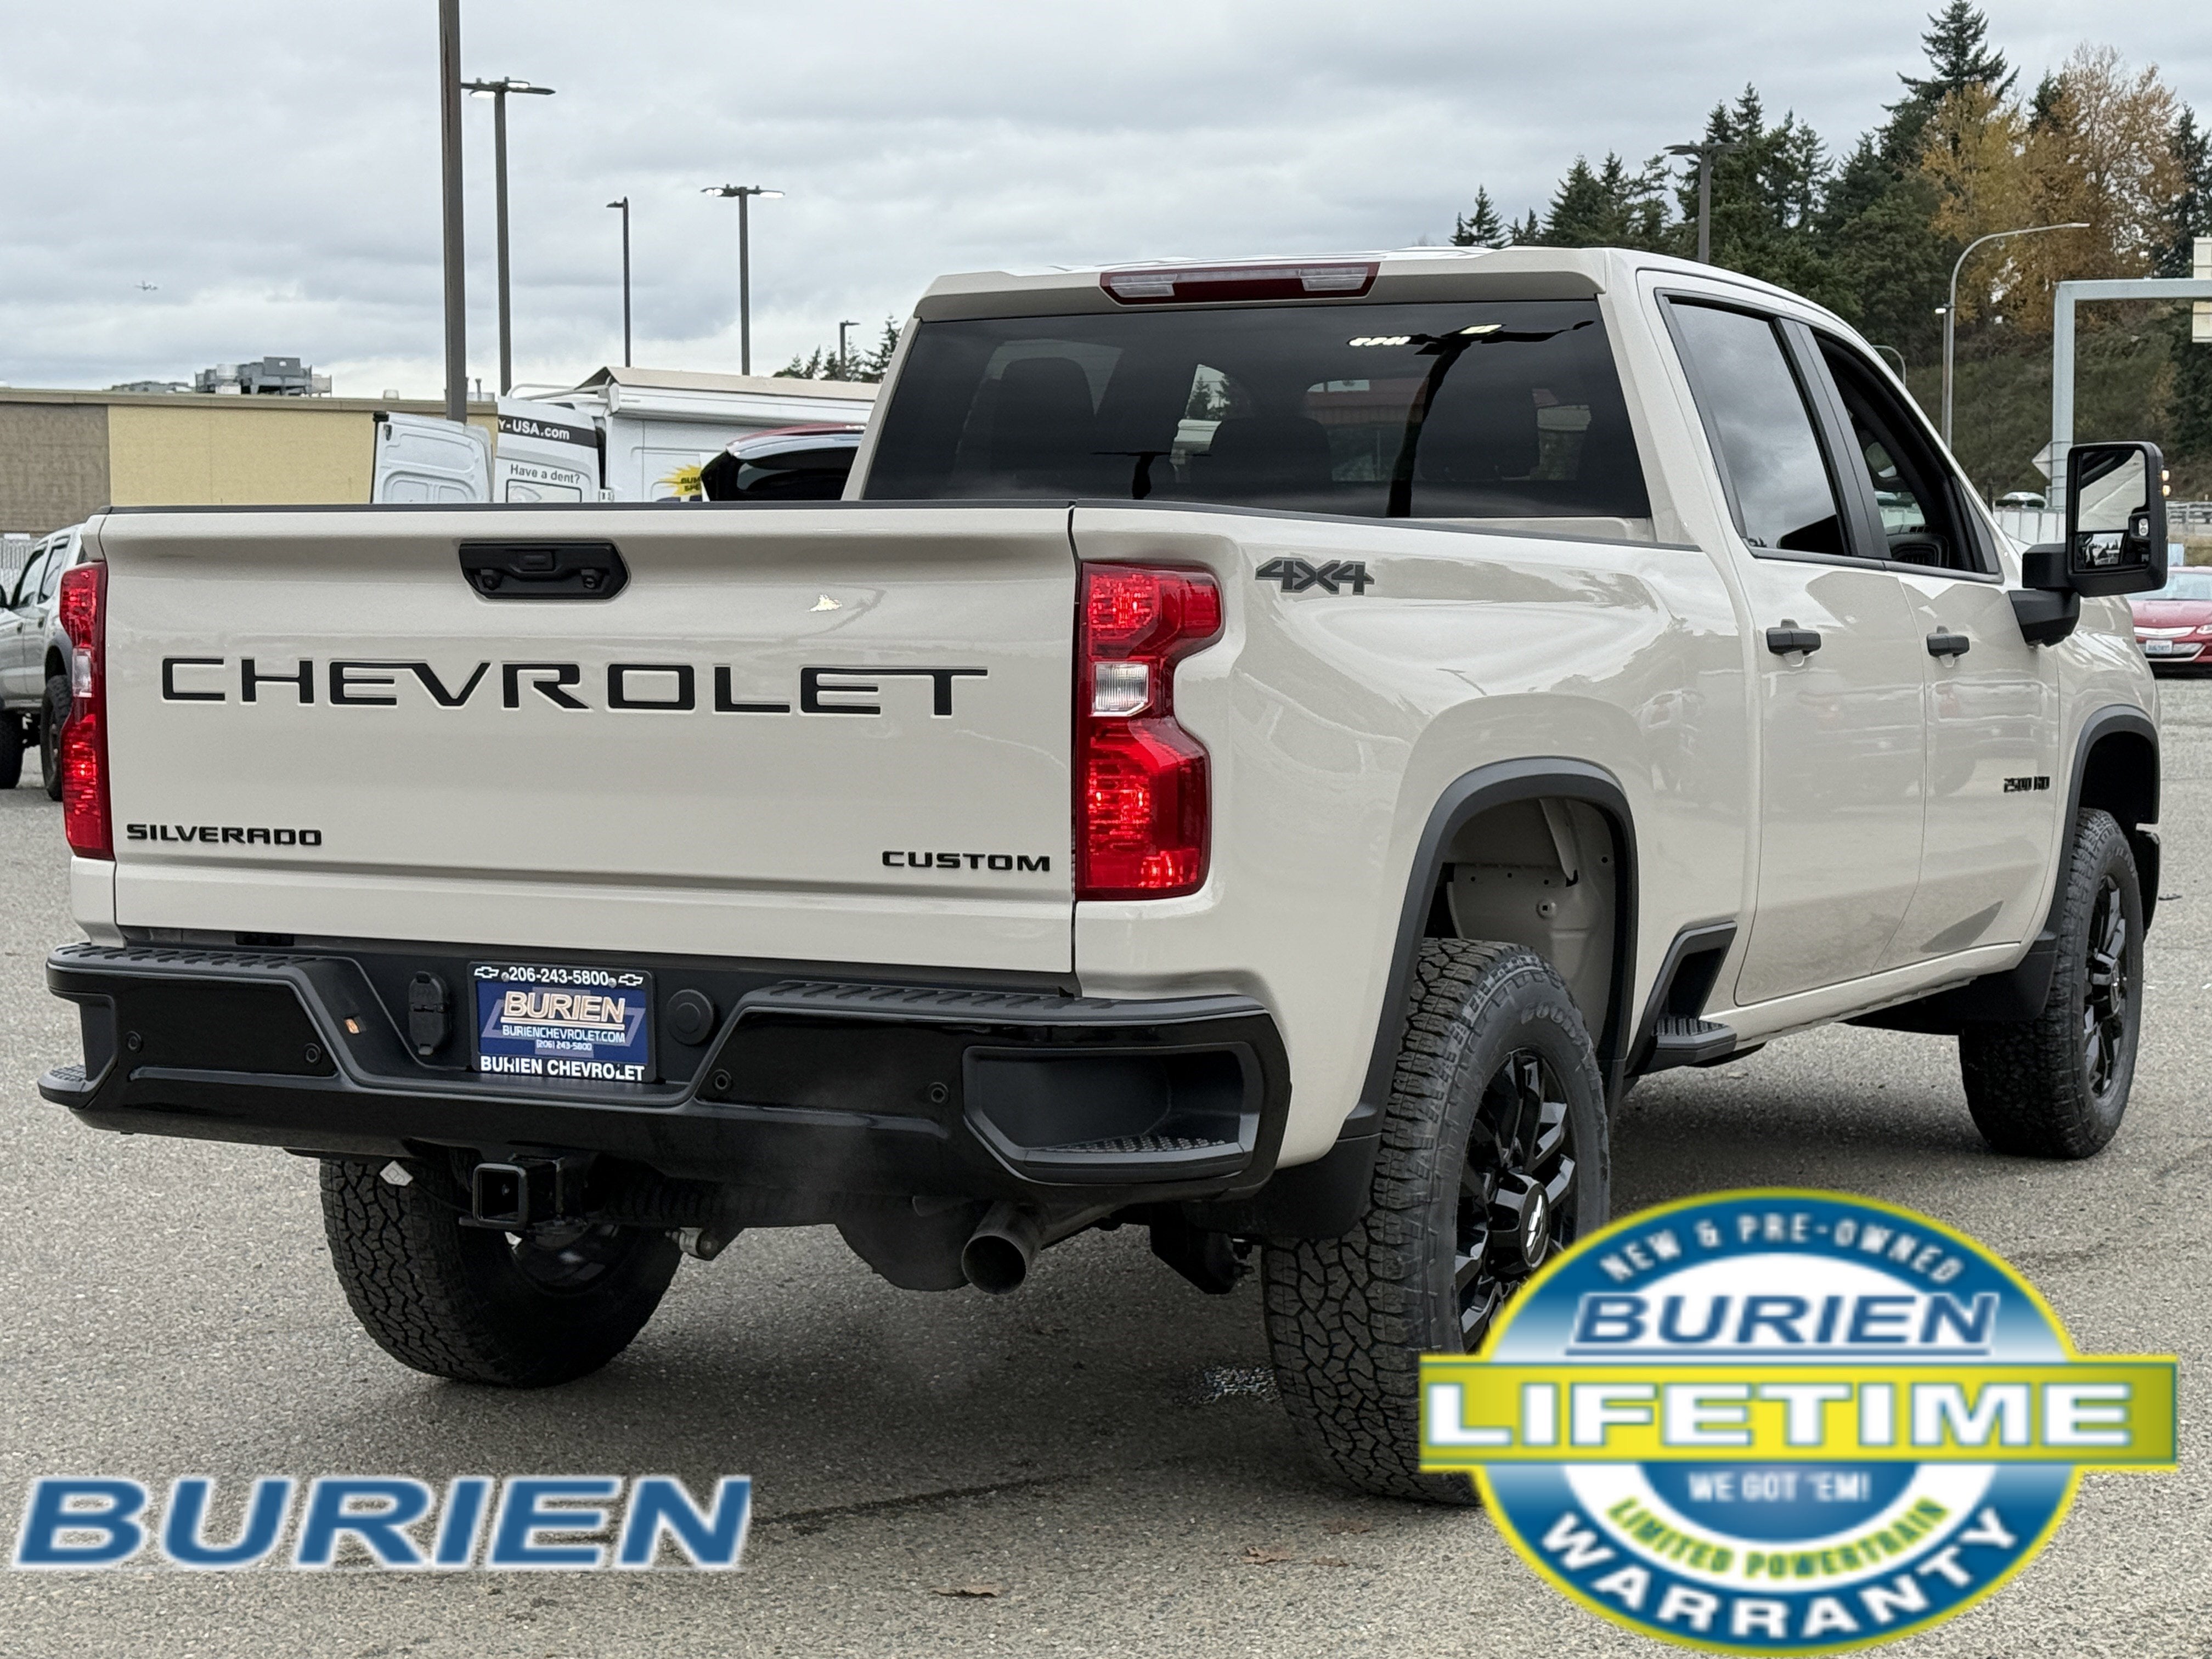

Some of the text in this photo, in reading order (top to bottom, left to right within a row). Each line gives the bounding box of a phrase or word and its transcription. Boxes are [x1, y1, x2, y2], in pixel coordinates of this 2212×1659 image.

[510, 464, 580, 484] Have a dent?
[160, 657, 988, 717] CHEVROLET
[2004, 777, 2032, 793] 2500
[127, 823, 323, 846] SILVERADO
[882, 850, 1051, 873] CUSTOM
[509, 967, 609, 986] 206-243-5800
[504, 991, 625, 1023] BURIEN
[502, 1025, 625, 1043] BURIENCHEVROLET.COM
[481, 1056, 645, 1081] BURIEN CHEVROLET
